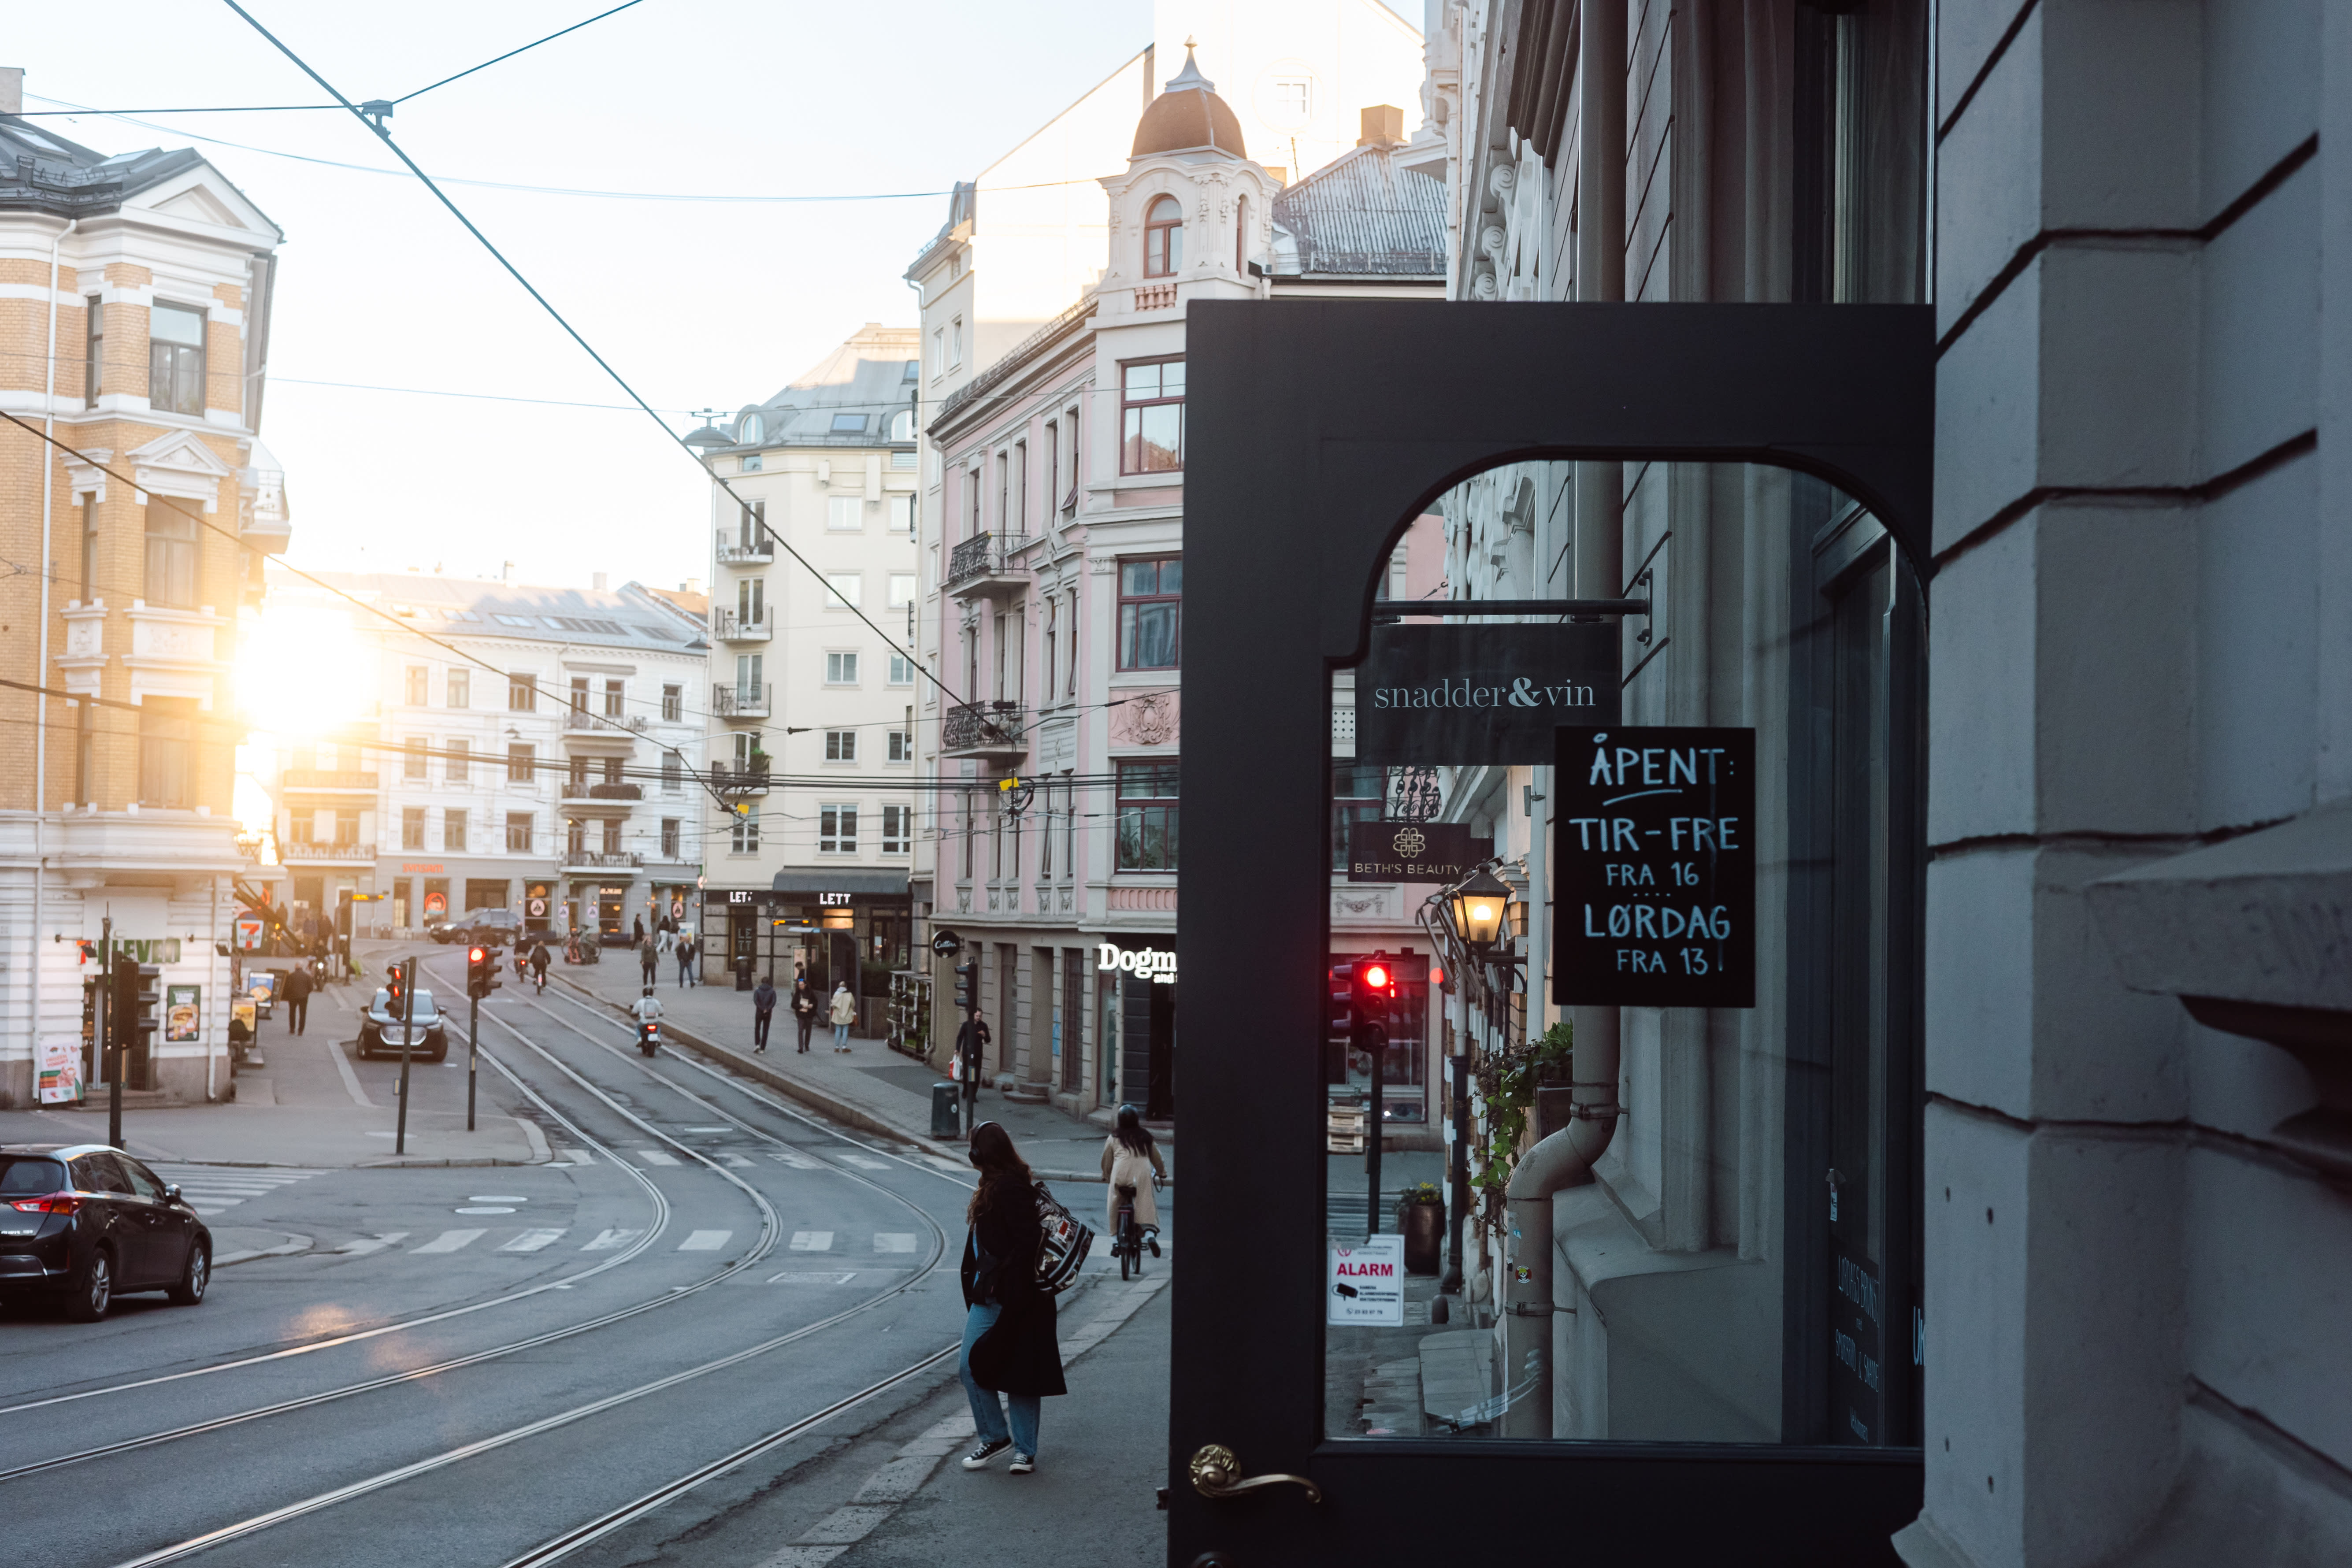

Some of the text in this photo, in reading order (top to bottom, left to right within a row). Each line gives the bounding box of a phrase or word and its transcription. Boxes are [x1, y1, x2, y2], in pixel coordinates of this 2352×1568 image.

[1375, 677, 1596, 708] snadder&vin
[1355, 863, 1462, 875] BETH'S BEAUTY
[1606, 862, 1699, 886] FRA 16
[820, 893, 851, 904] LETT
[1585, 903, 1731, 939] LØRDAG
[1617, 947, 1709, 975] FRA 13
[1154, 972, 1175, 984] and
[1337, 1263, 1393, 1276] ALARM
